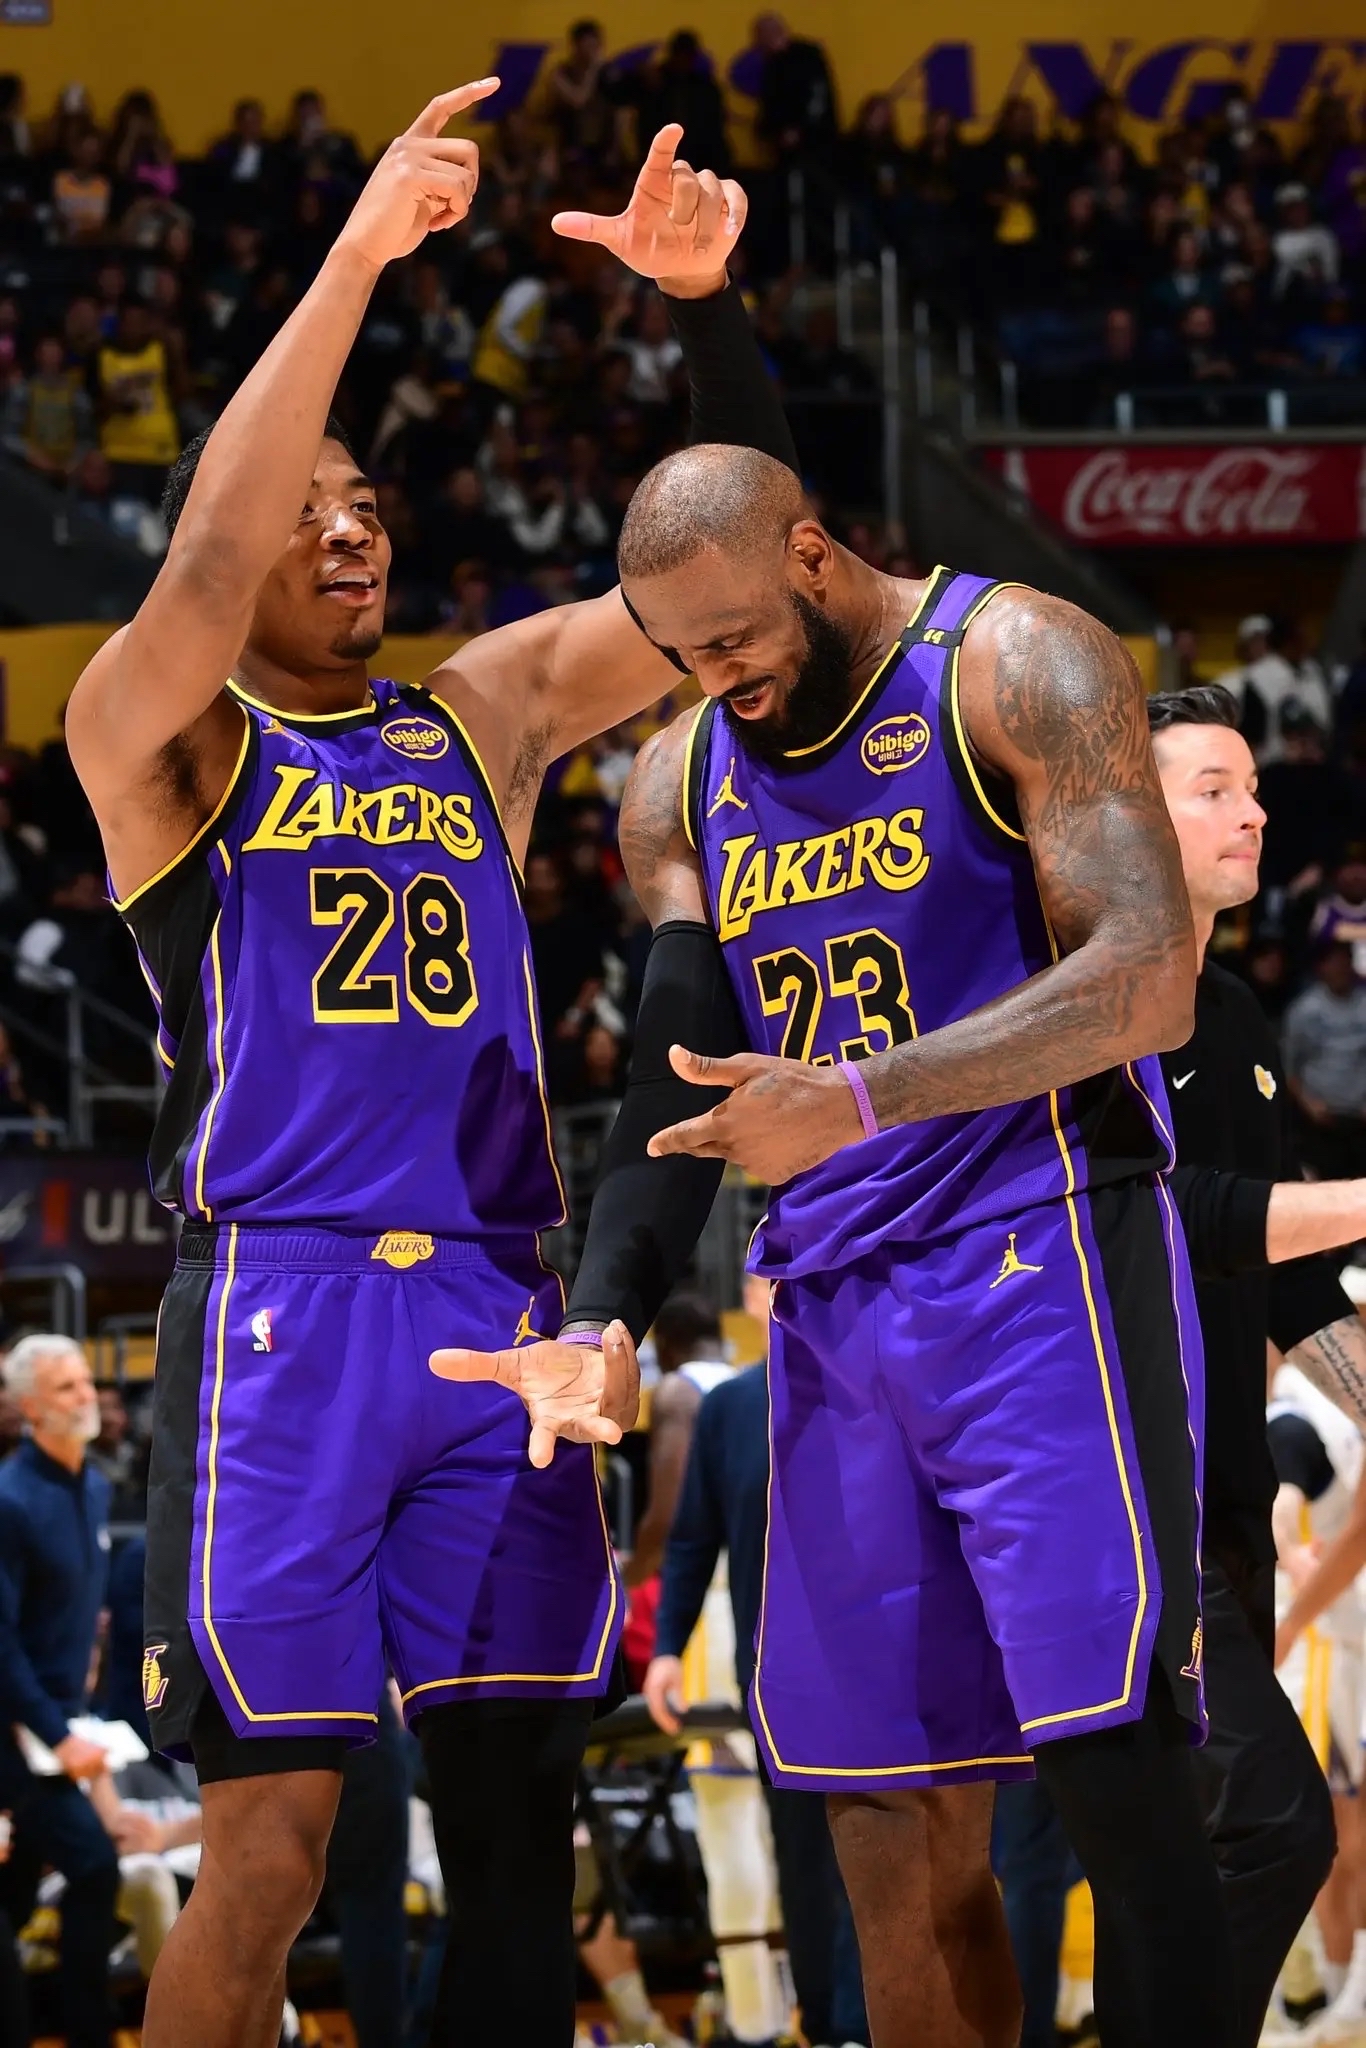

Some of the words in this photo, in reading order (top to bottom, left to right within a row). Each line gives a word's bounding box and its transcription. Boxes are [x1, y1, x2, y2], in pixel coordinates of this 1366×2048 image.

[385, 728, 443, 747] bibigo
[867, 730, 926, 756] bibigo
[241, 764, 483, 861] LAKERS
[718, 808, 931, 943] LAKERS
[309, 867, 480, 1028] 28
[752, 927, 918, 1066] 23
[83, 1187, 183, 1245] UL
[377, 1237, 430, 1258] LAKERS
